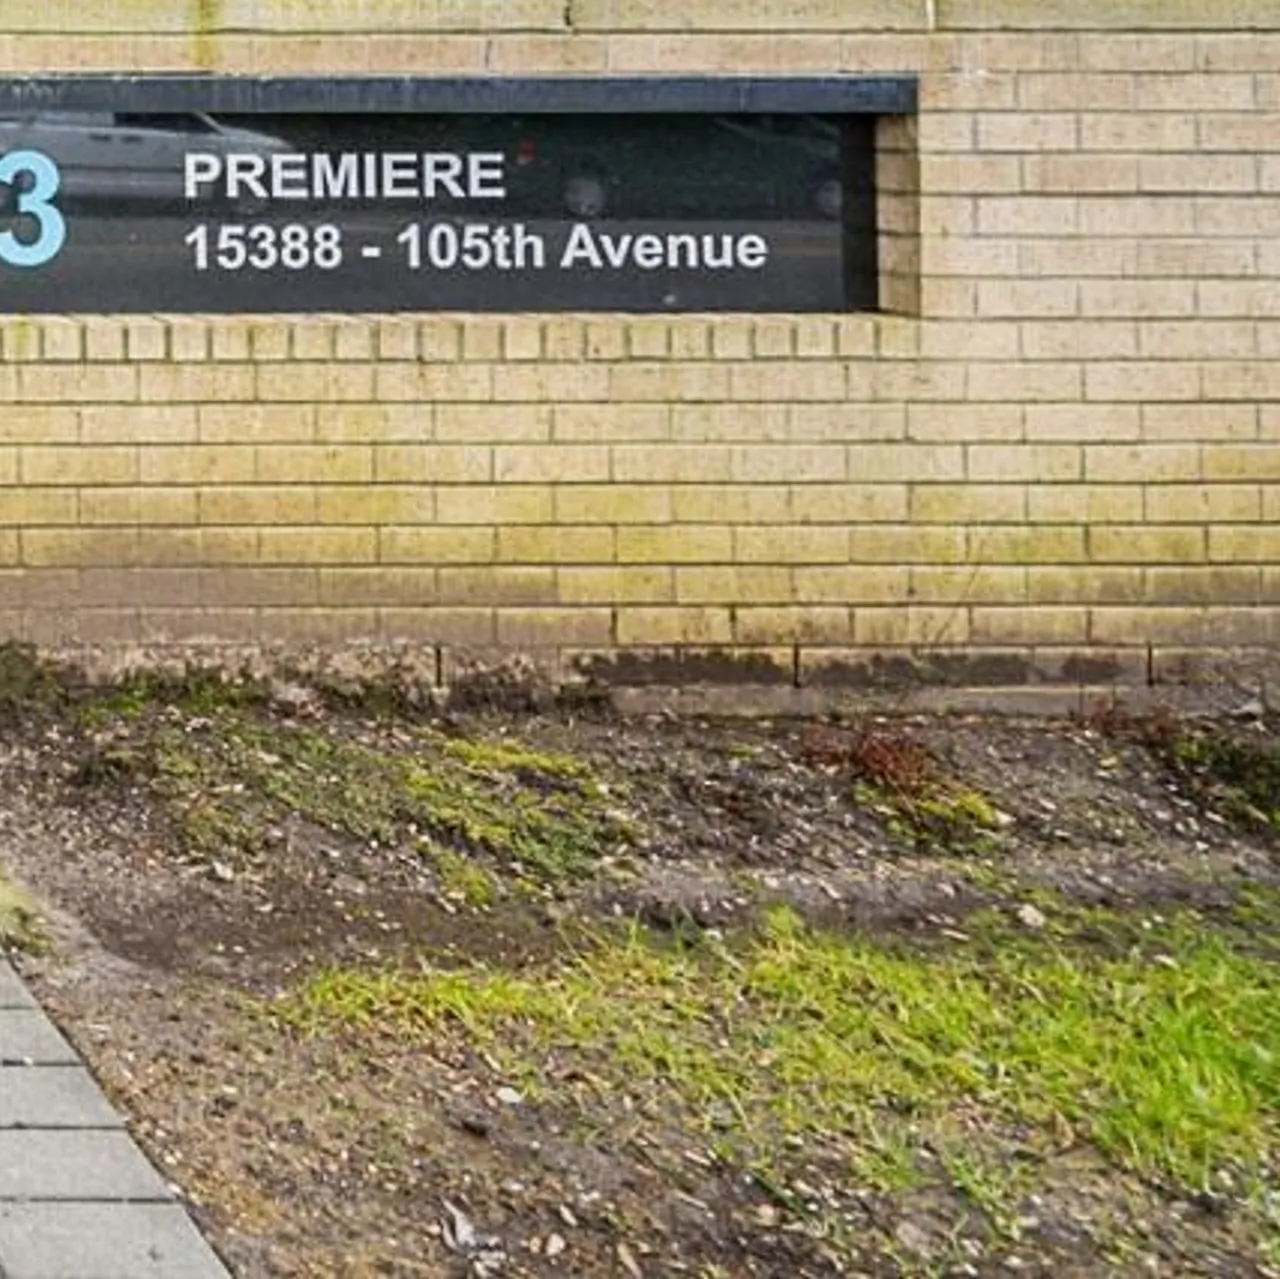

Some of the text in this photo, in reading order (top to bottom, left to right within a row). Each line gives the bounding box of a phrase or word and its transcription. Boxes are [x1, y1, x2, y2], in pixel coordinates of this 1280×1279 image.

[185, 152, 505, 198] PREMIERE
[185, 224, 342, 269] 15388
[398, 223, 544, 269] 105th
[559, 223, 768, 269] Avenue
